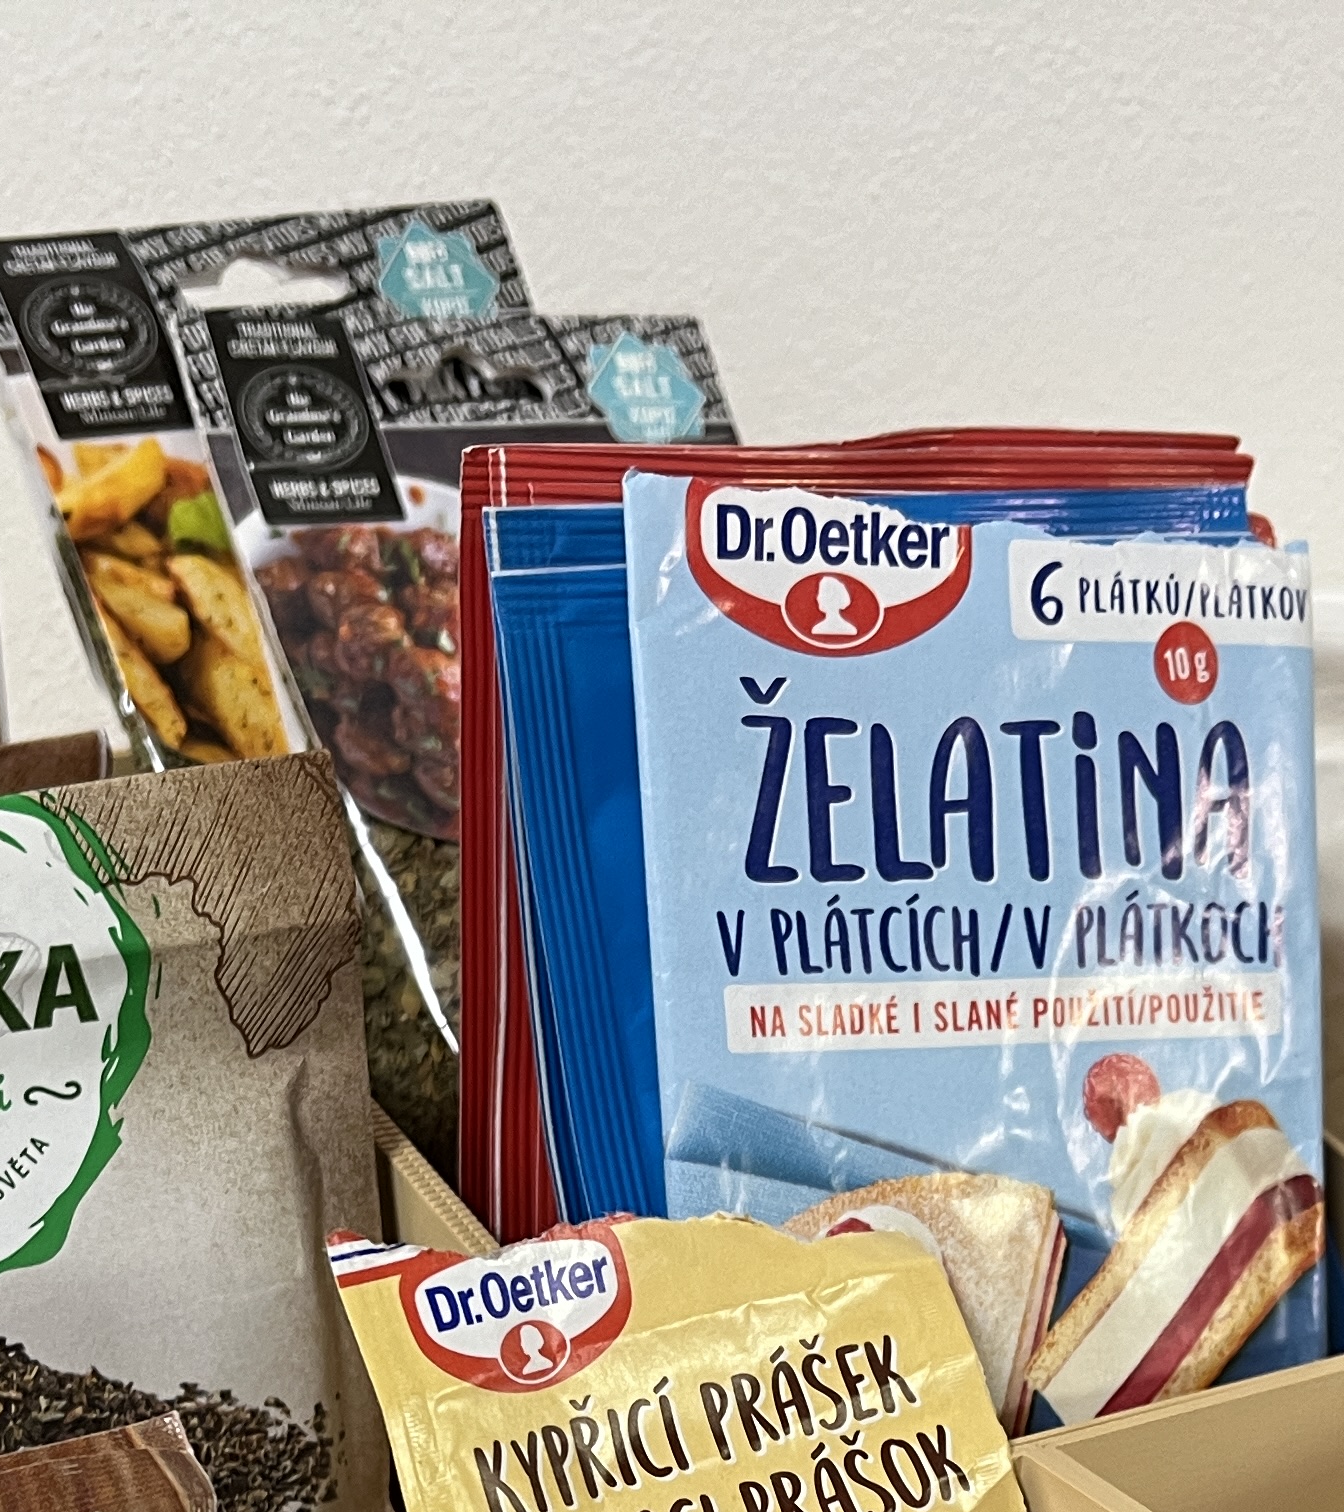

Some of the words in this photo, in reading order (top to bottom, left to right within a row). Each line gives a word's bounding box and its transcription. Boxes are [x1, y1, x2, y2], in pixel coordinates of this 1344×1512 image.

[61, 389, 110, 412] HERBS
[122, 384, 173, 406] SPICES
[269, 478, 318, 499] HERBS
[330, 475, 380, 497] SPICES
[1030, 561, 1063, 625] 6
[1164, 647, 1190, 681] 10
[1194, 651, 1210, 683] g
[716, 909, 745, 977] V
[1076, 889, 1284, 968] PLÁTKOCH
[750, 1003, 786, 1040] NA
[798, 990, 899, 1036] SLADKÉ
[913, 1001, 921, 1034] I
[934, 991, 1020, 1033] SLANÉ
[699, 1333, 917, 1463] PRÁŠEK
